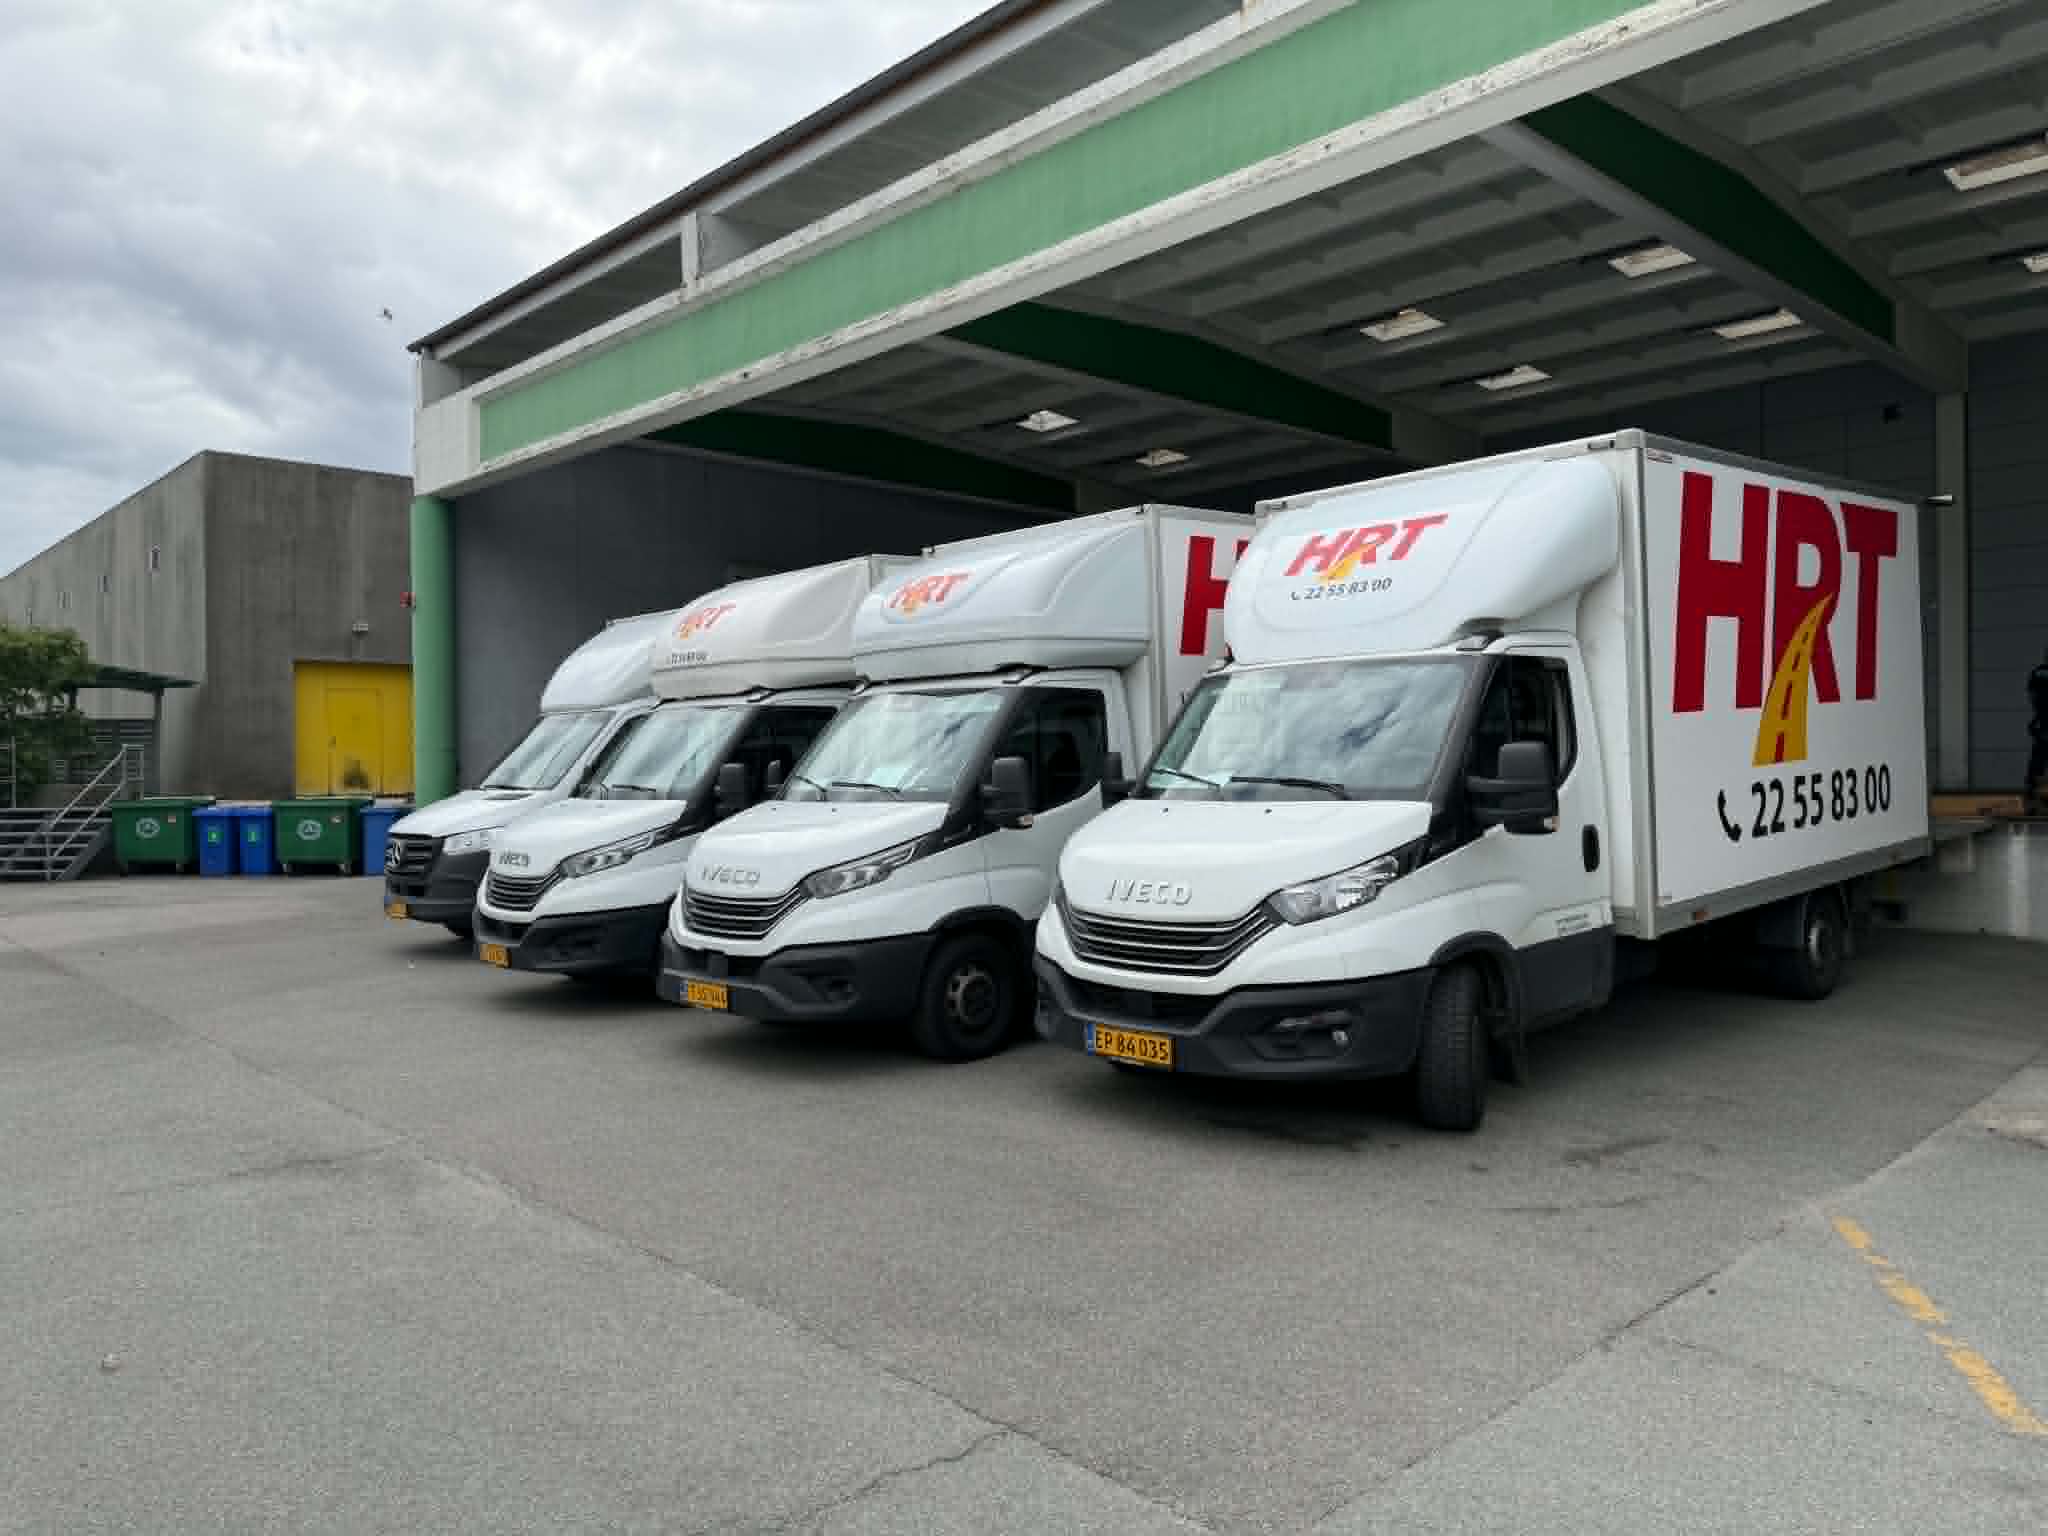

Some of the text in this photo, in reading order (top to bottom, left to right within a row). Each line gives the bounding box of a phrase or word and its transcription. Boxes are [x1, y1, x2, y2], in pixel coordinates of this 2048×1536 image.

[1282, 513, 1449, 577] HRT
[886, 573, 970, 609] HRT
[1303, 585, 1323, 600] 22
[1327, 583, 1345, 597] 55
[1371, 577, 1393, 592] 00
[1673, 471, 1898, 712] HRT
[1751, 763, 1891, 838] 22 55 83 00
[702, 864, 761, 887] IVECO
[1106, 879, 1193, 906] IVECO
